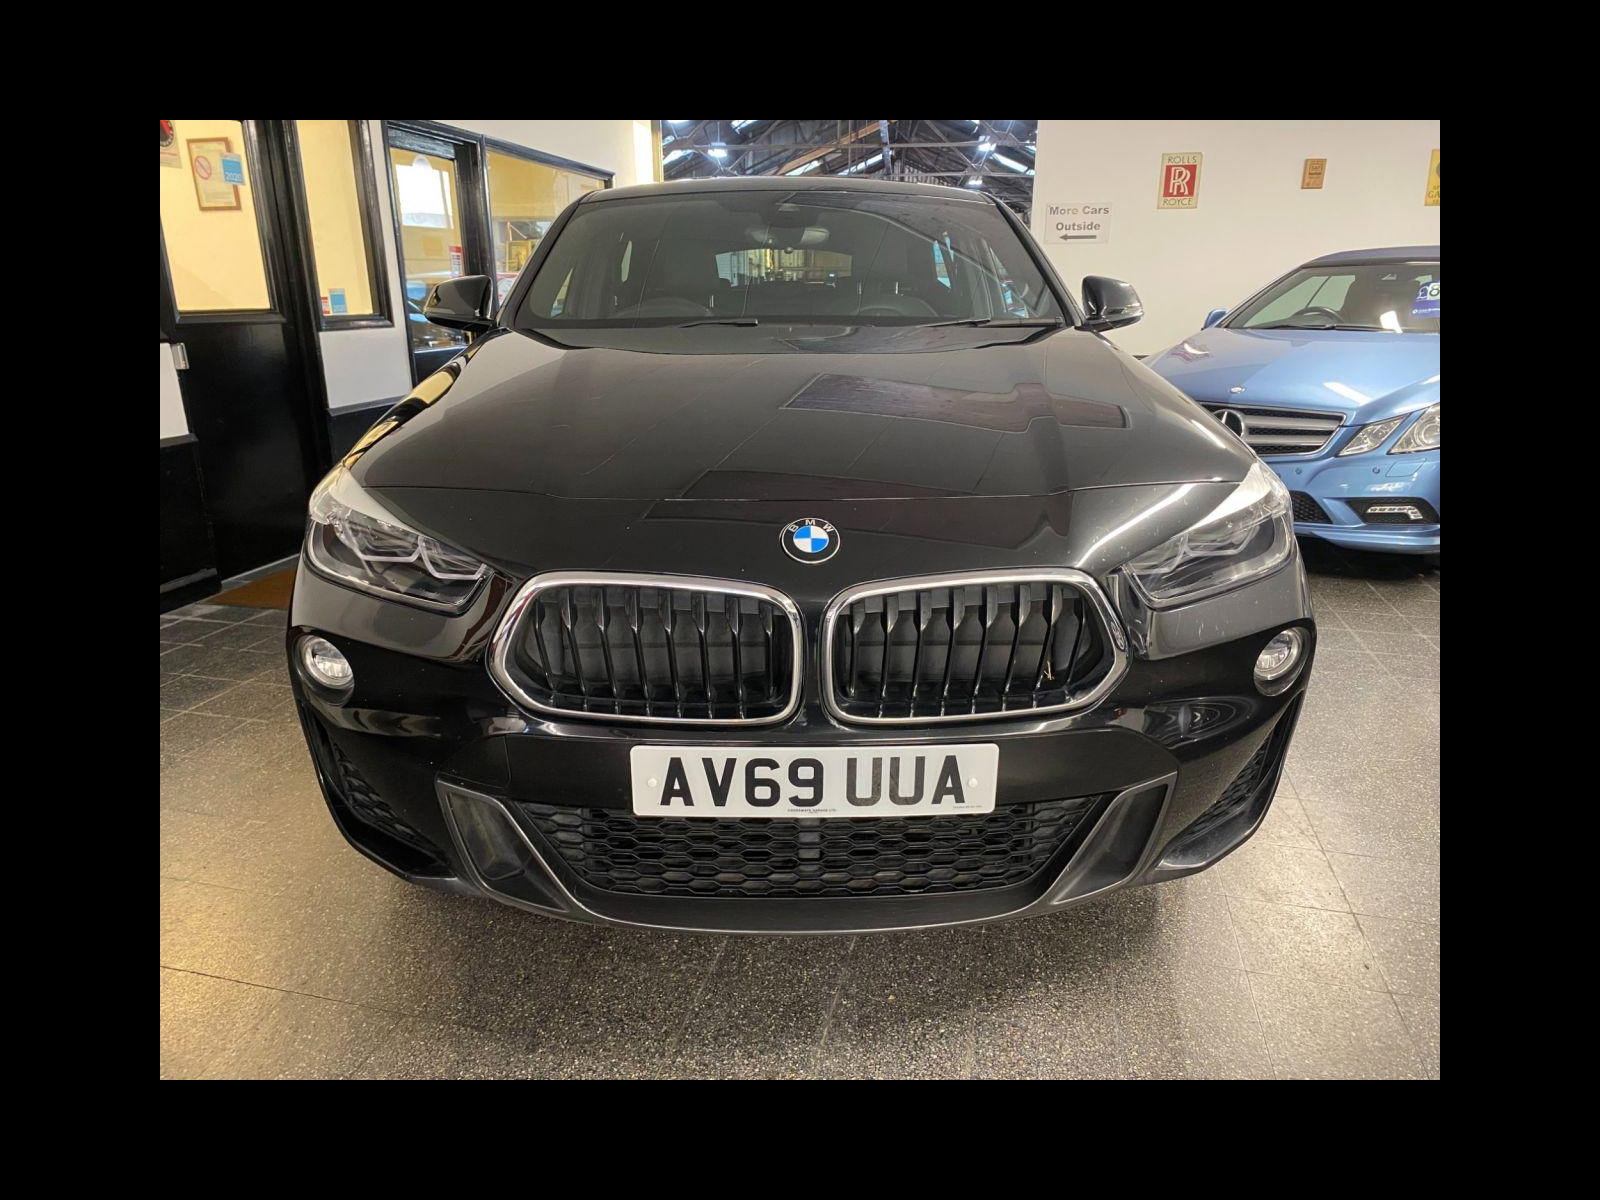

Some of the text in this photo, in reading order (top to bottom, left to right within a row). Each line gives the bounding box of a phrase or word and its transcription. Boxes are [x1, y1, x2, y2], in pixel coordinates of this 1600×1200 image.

[1168, 155, 1197, 163] ROLLS
[1162, 198, 1193, 206] ROYCE
[1049, 205, 1110, 215] More Cars
[1056, 221, 1101, 231] Outside
[788, 519, 834, 532] BMW
[660, 755, 966, 807] AV69 UUA
